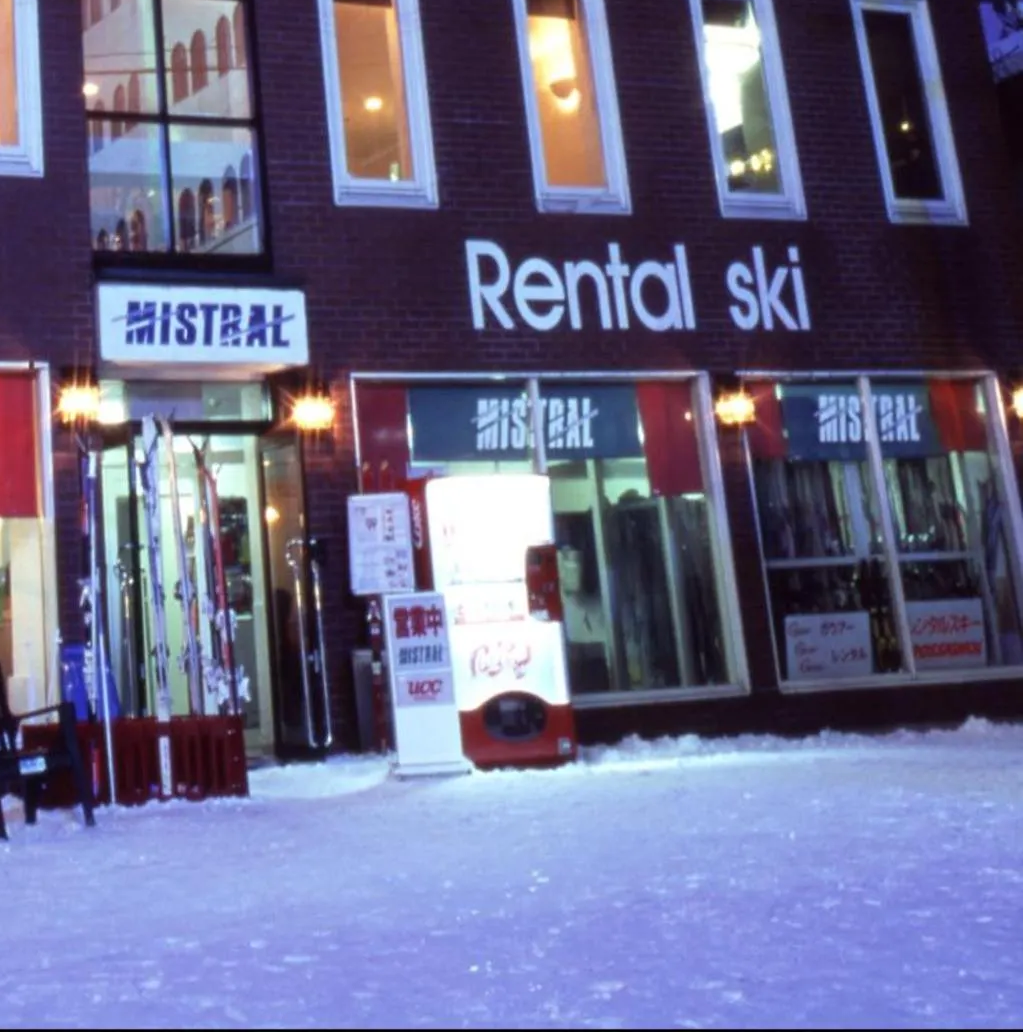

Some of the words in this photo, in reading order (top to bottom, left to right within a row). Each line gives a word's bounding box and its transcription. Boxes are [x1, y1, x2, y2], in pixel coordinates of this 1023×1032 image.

[465, 239, 696, 332] Rental
[726, 246, 811, 332] ski
[114, 300, 295, 348] MISTRAL
